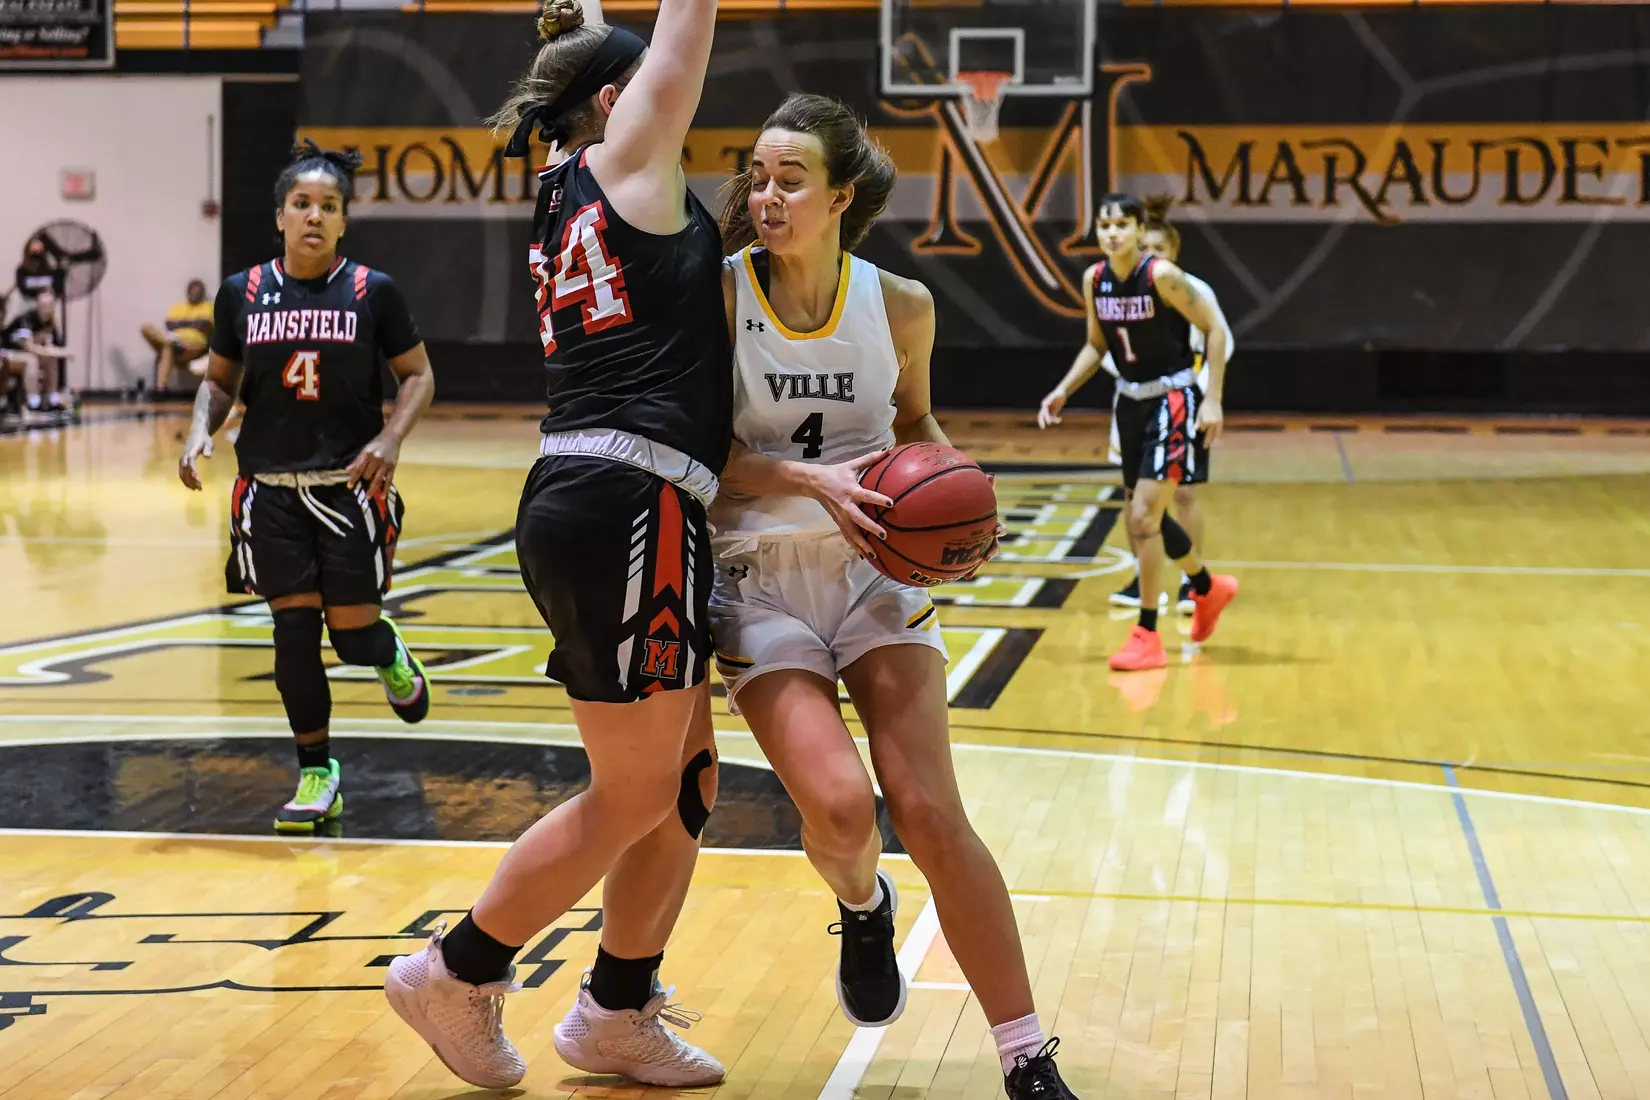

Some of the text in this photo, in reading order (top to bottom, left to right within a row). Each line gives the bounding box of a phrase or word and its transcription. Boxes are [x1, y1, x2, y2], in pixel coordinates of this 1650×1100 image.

[246, 308, 358, 346] MANSFIELD
[1115, 326, 1138, 363] 1
[282, 349, 321, 401] 4
[764, 372, 855, 403] VILLE
[790, 412, 824, 459] 4
[640, 638, 681, 680] M
